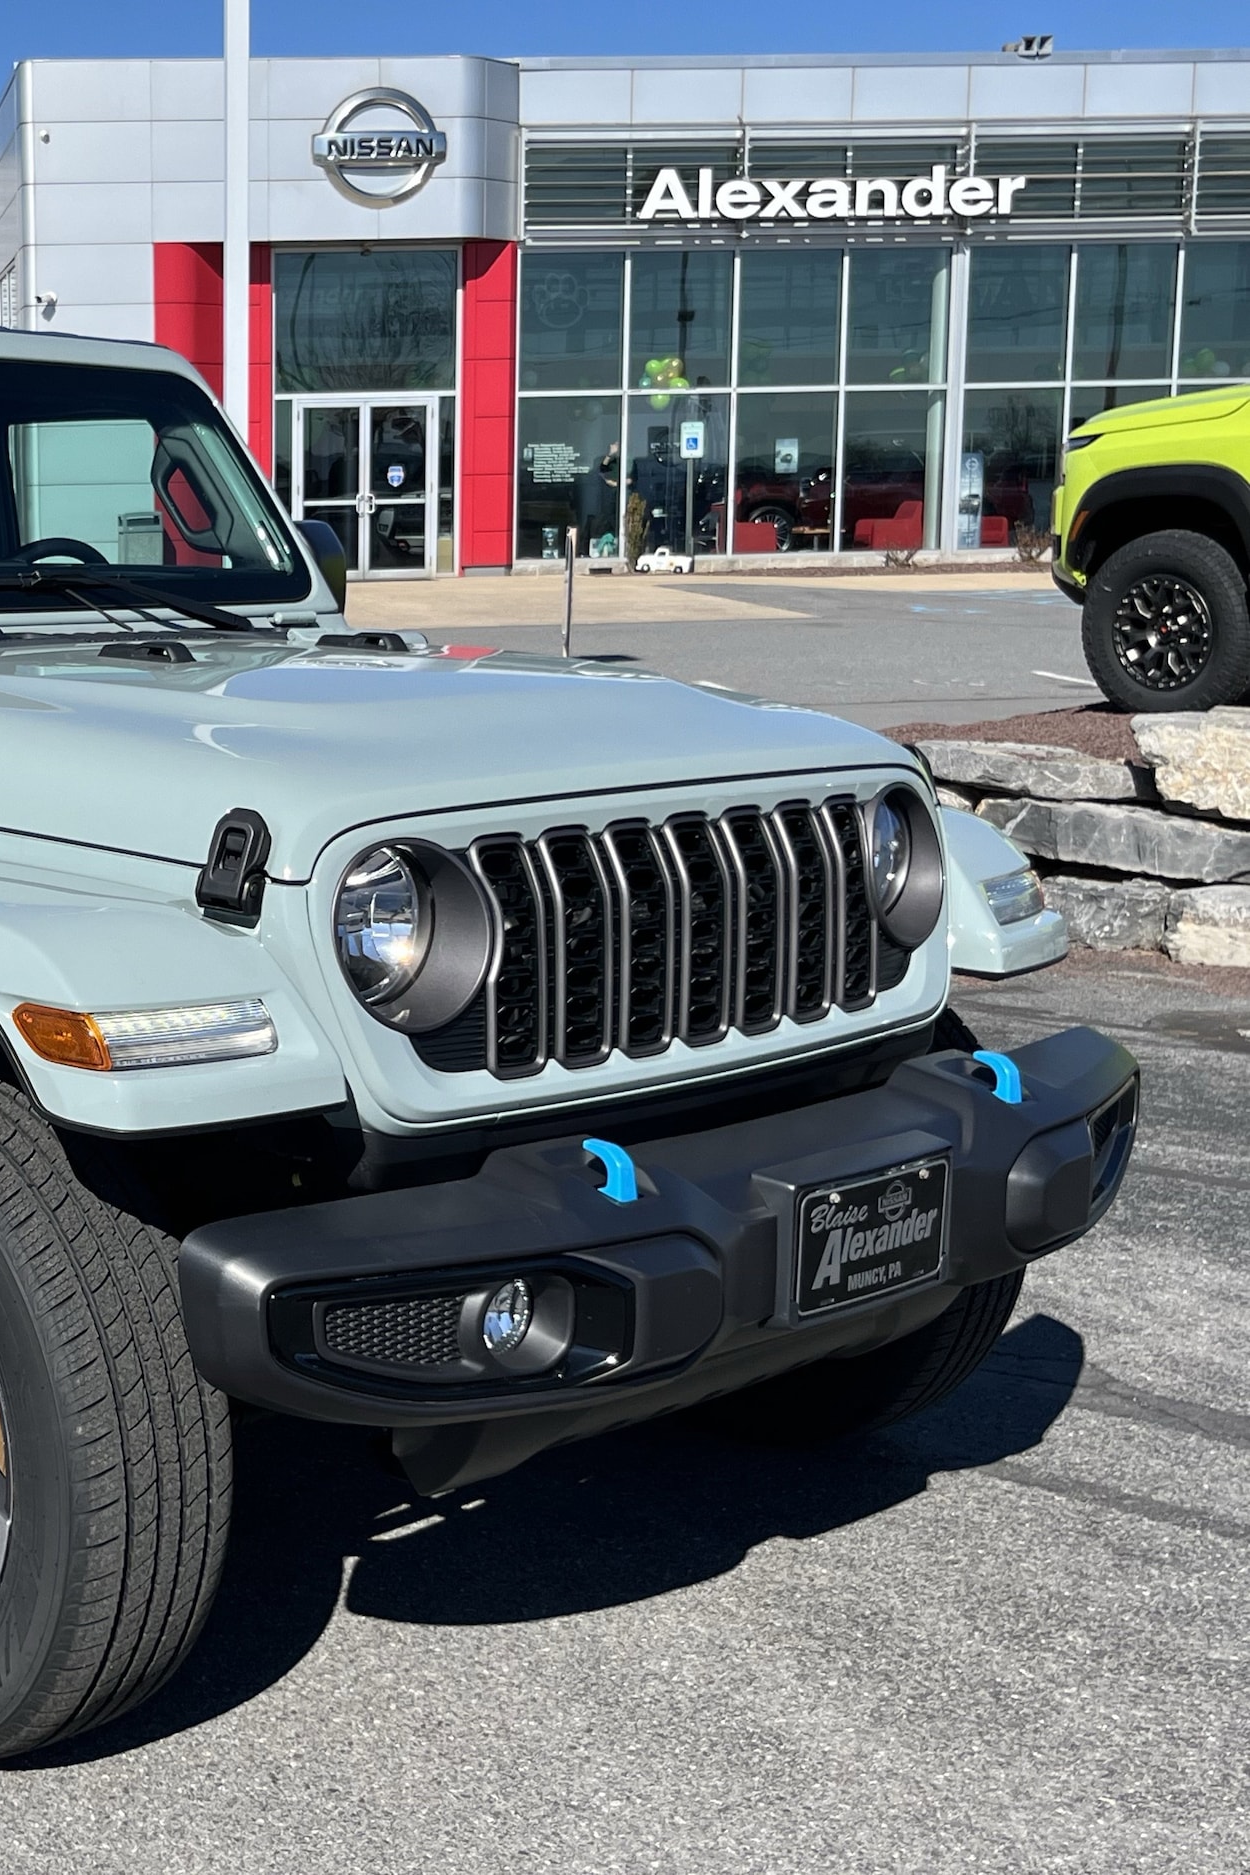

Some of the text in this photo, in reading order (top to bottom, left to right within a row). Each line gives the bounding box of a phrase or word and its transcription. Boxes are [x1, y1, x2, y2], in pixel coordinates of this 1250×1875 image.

[327, 137, 435, 160] NISSAN
[637, 164, 1027, 220] Alexander
[810, 1203, 869, 1234] Blaise
[810, 1207, 938, 1291] Alexander
[847, 1261, 902, 1292] MUNCY, PA
